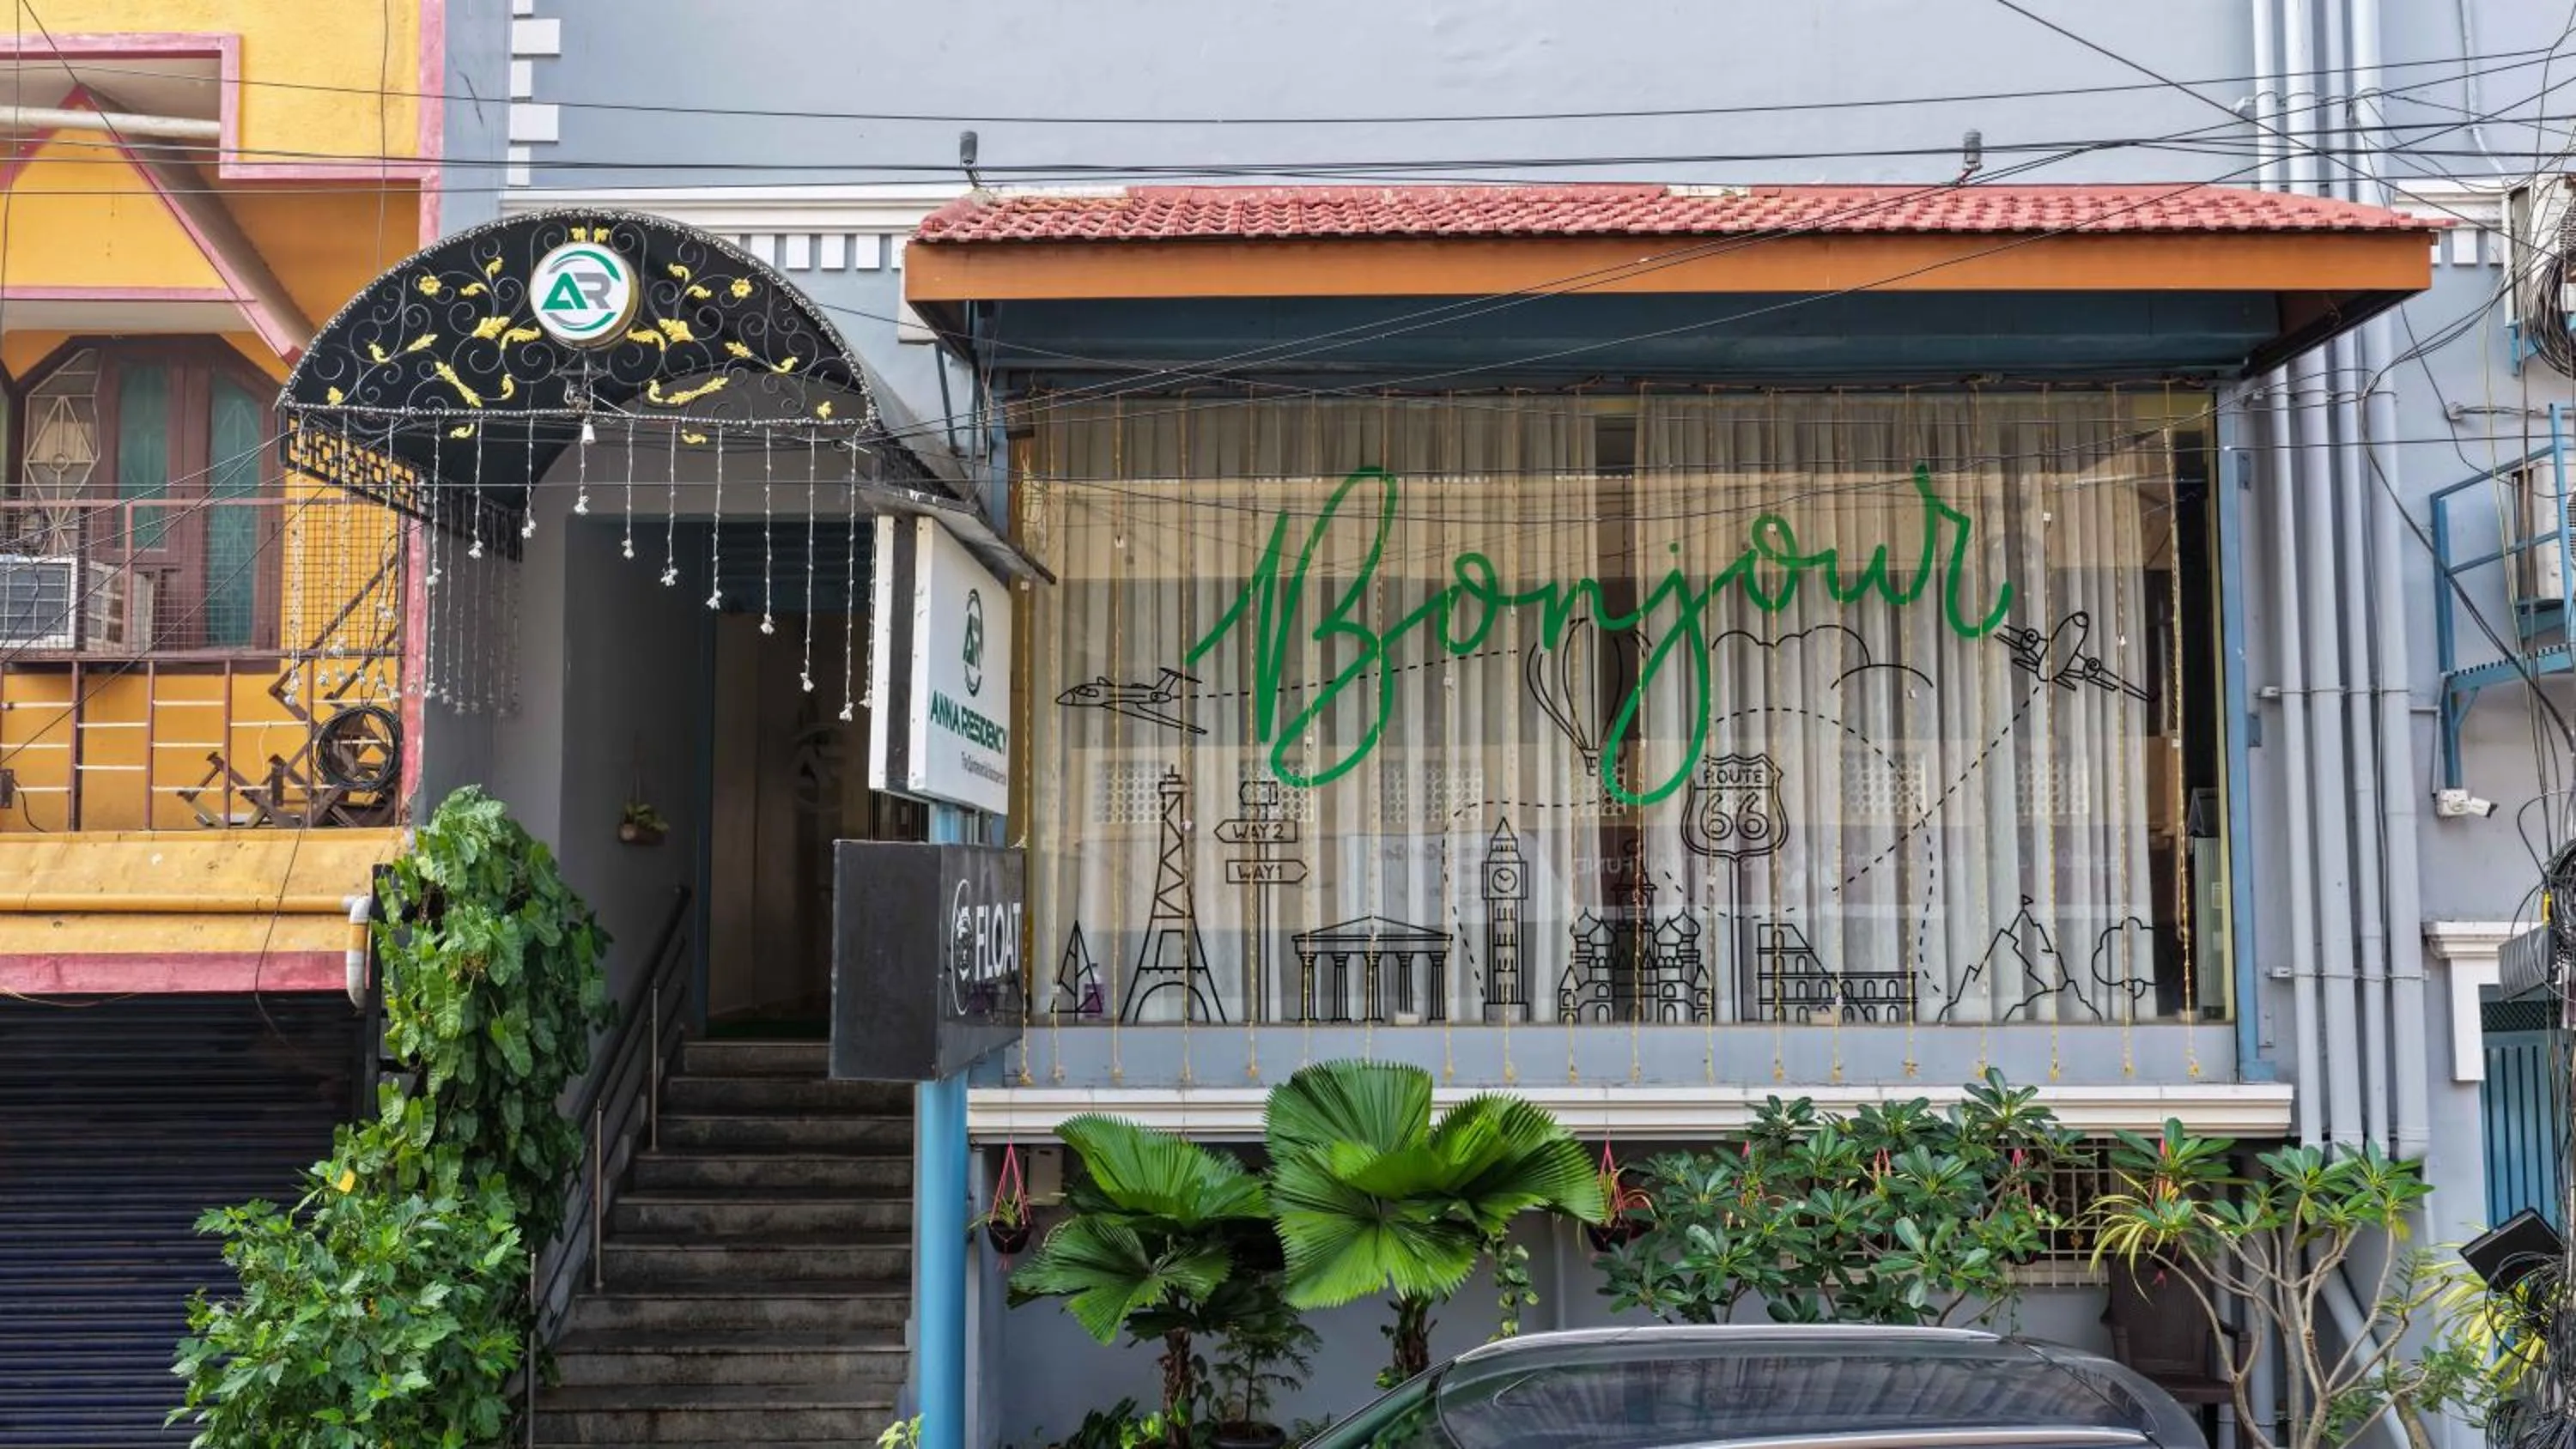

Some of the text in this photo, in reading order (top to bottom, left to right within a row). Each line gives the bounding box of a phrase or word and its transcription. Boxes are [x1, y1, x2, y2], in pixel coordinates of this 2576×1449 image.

[541, 271, 611, 310] AR
[1185, 466, 2012, 805] Bonjour
[930, 689, 961, 736] ANNA
[1704, 768, 1765, 784] ROUTE
[1700, 791, 1770, 840] 66
[976, 903, 1021, 980] FLOAT
